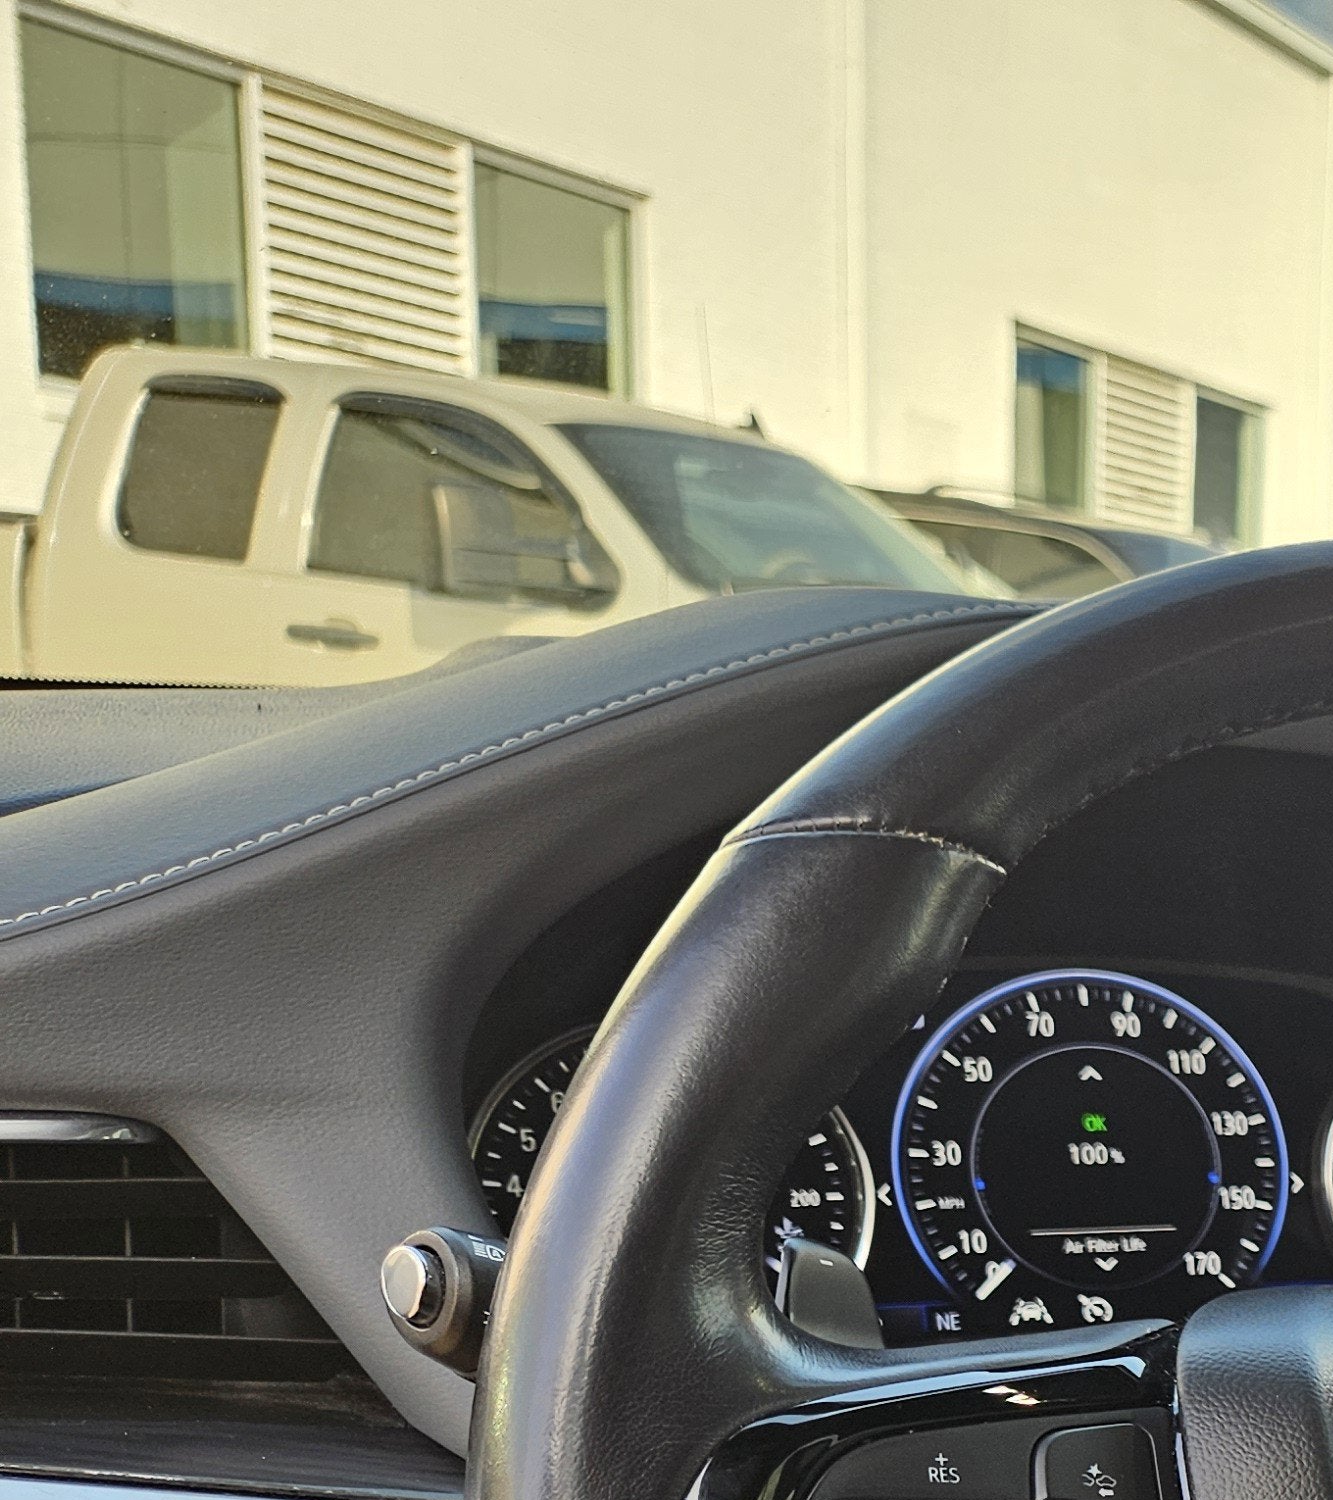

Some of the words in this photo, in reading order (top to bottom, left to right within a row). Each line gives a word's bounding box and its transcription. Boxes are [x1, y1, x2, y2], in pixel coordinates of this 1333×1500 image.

[1026, 1011, 1055, 1038] 70
[1110, 1011, 1142, 1038] 90
[962, 1056, 993, 1083] 50
[1168, 1049, 1207, 1076] 110
[1081, 1112, 1108, 1132] OK
[1212, 1110, 1249, 1136] 130
[519, 1128, 537, 1152] 5
[932, 1140, 962, 1167] 30
[506, 1174, 524, 1198] 4
[1218, 1185, 1255, 1211] 150
[957, 1228, 988, 1255] 10
[1184, 1251, 1222, 1276] 170
[934, 1310, 962, 1332] NE
[928, 1465, 961, 1484] RES
